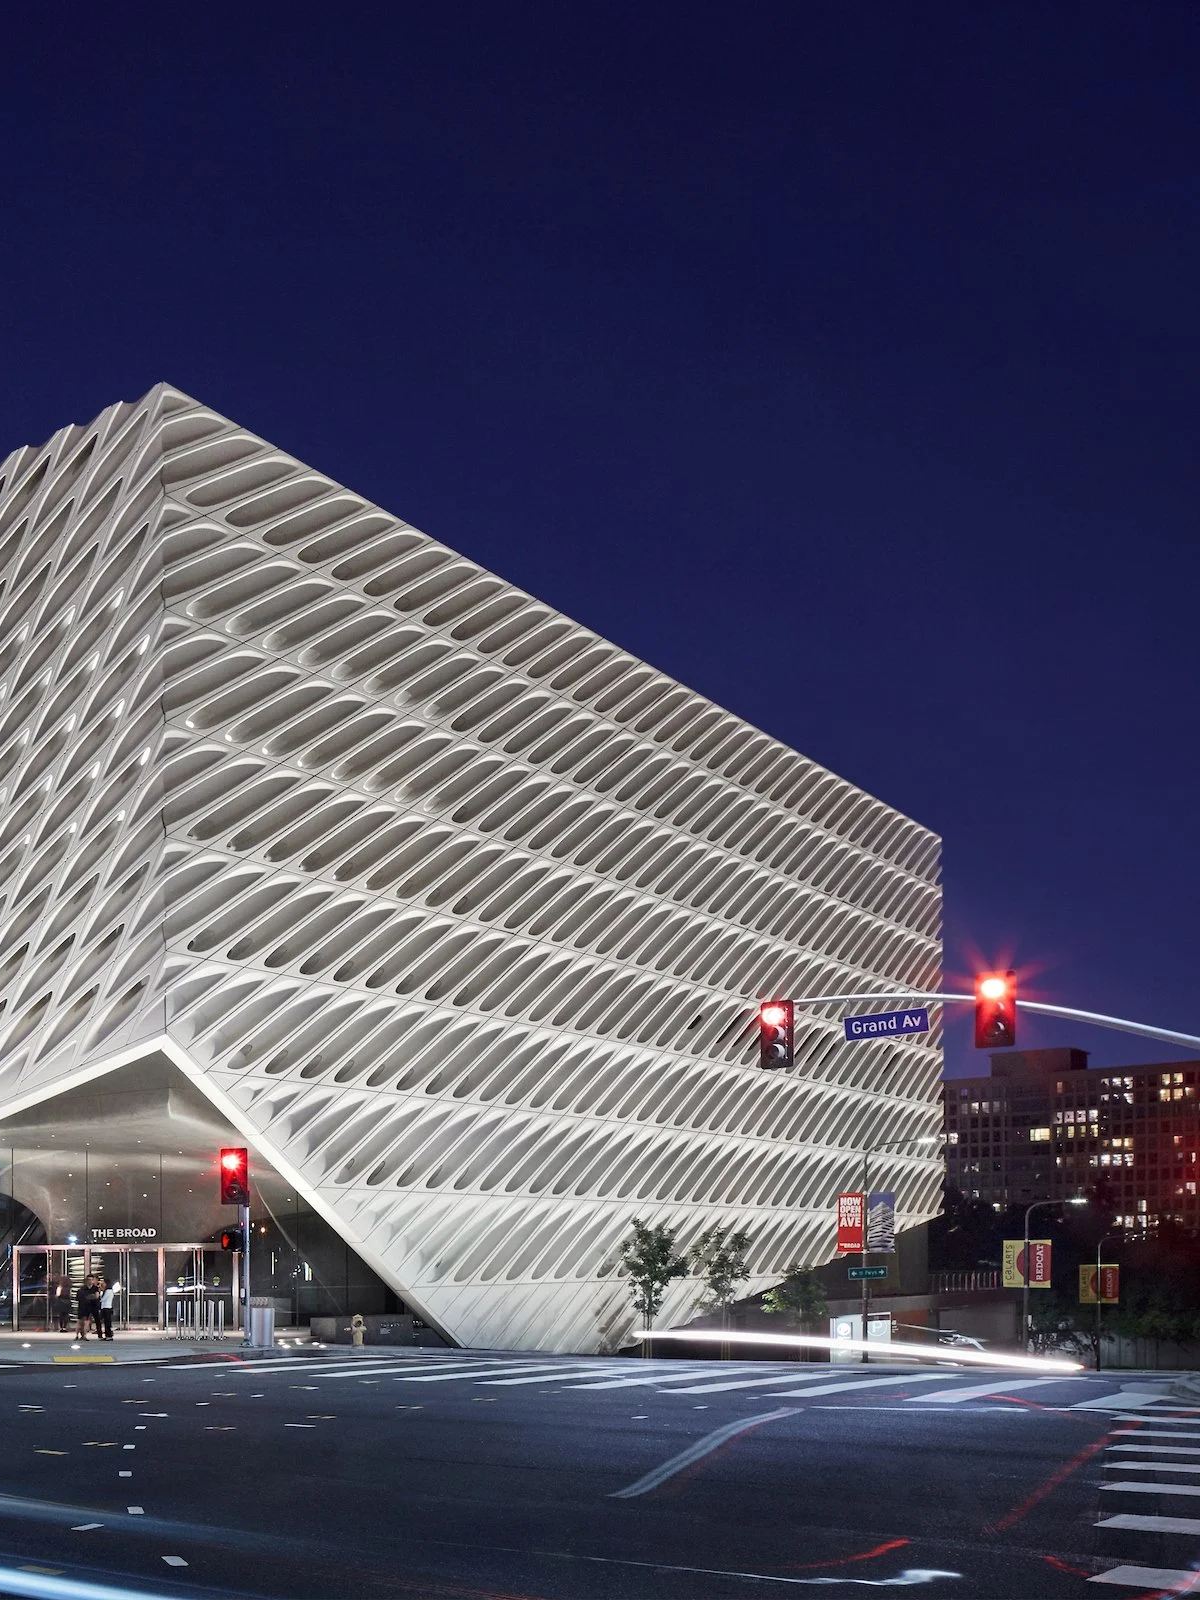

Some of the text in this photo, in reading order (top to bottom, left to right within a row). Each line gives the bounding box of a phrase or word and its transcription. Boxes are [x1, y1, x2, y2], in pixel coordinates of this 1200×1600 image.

[851, 1015, 921, 1034] Grand Av
[839, 1197, 861, 1205] NOW
[839, 1205, 861, 1213] OPEN
[839, 1217, 861, 1227] AVE
[91, 1228, 157, 1238] THE BROAD
[1035, 1245, 1043, 1280] REDCAT
